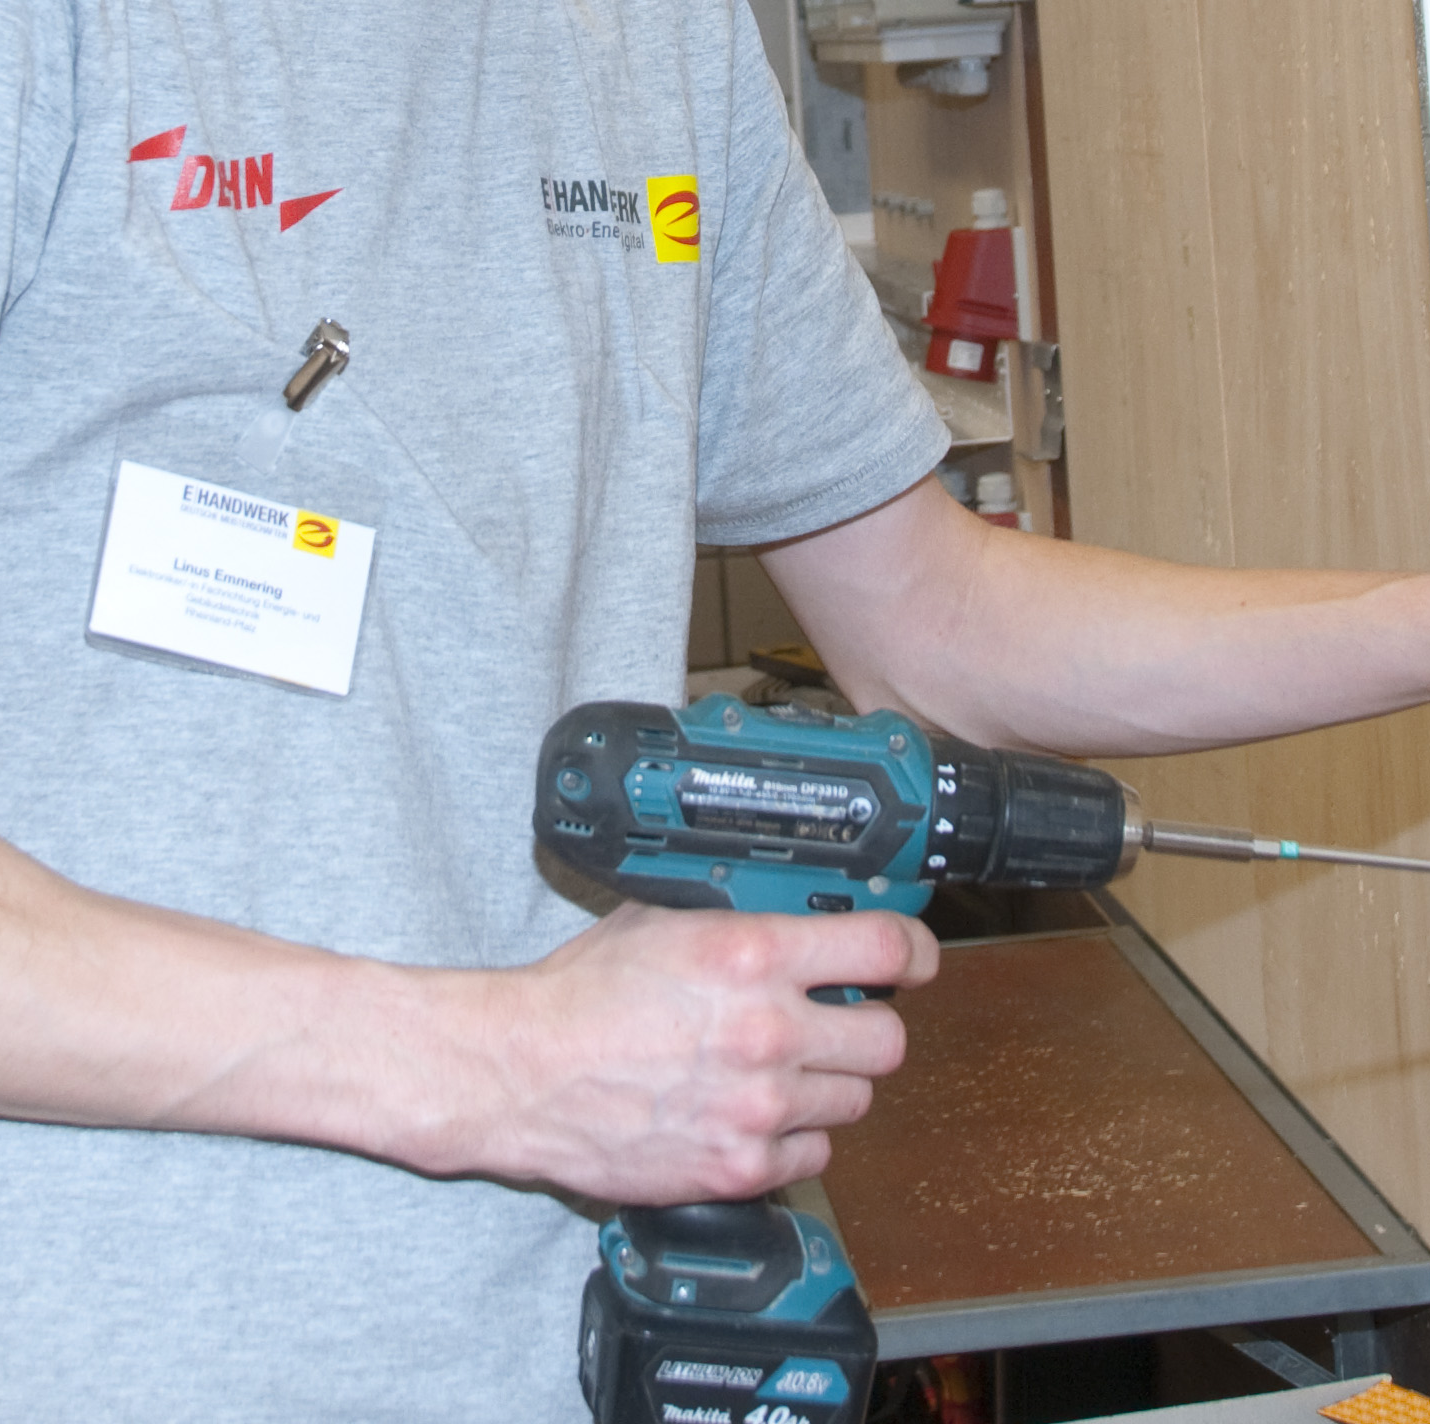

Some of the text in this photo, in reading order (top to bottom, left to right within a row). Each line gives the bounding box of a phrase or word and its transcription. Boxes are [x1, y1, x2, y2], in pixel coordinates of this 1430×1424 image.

[173, 558, 283, 600] Linus Emmering
[691, 768, 757, 789] makita
[801, 782, 848, 798] DF331D
[663, 1403, 732, 1424] makita
